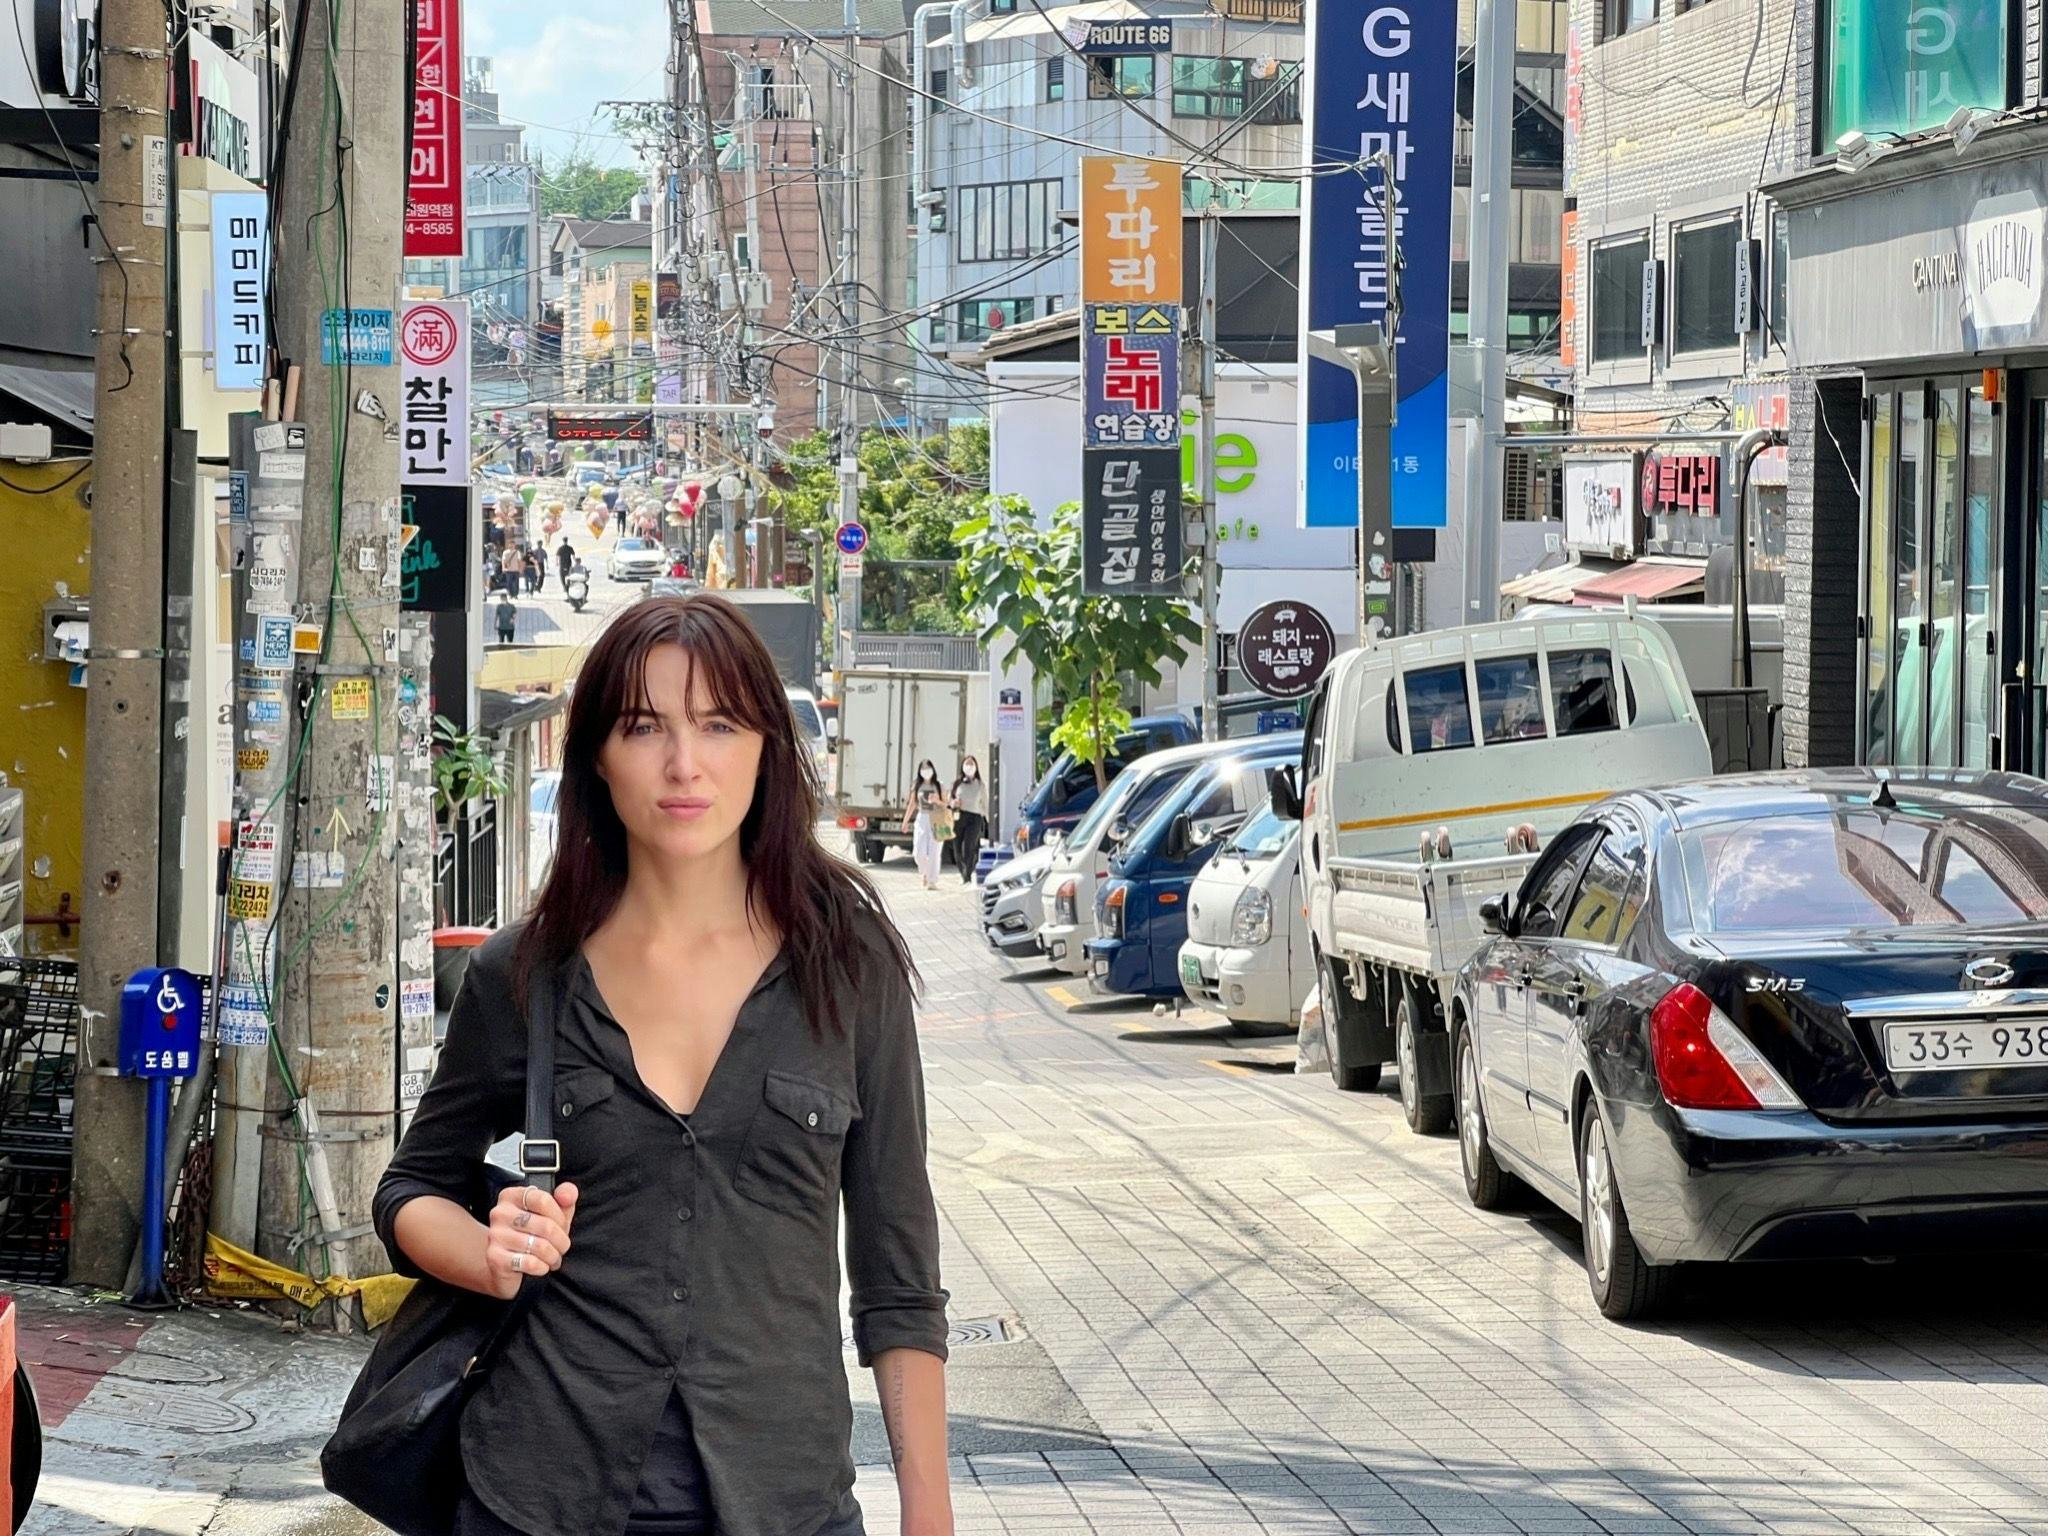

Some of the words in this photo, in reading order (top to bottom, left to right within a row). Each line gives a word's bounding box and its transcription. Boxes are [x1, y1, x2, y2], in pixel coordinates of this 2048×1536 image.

[1090, 25, 1146, 45] ROUTE
[1149, 25, 1170, 44] 66
[406, 223, 454, 235] 4-8585
[1103, 163, 1160, 295] 투다리
[1911, 252, 1960, 294] CANTINA
[1976, 220, 2034, 295] HACIENDA
[413, 319, 443, 352] 滿
[1094, 307, 1172, 334] 보스
[1103, 336, 1162, 413] 노래
[404, 376, 453, 474] 찰만
[1094, 413, 1176, 442] 연습장
[1658, 456, 1718, 518] 투다리
[1100, 461, 1141, 585] 단골집
[402, 540, 440, 574] ink
[264, 642, 288, 650] HERO
[1272, 627, 1300, 647] 돼지
[1258, 646, 1314, 667] 래스토랑
[1745, 977, 1806, 992] SM5
[145, 1050, 189, 1069] 도움벨
[1908, 1030, 1974, 1062] 33수
